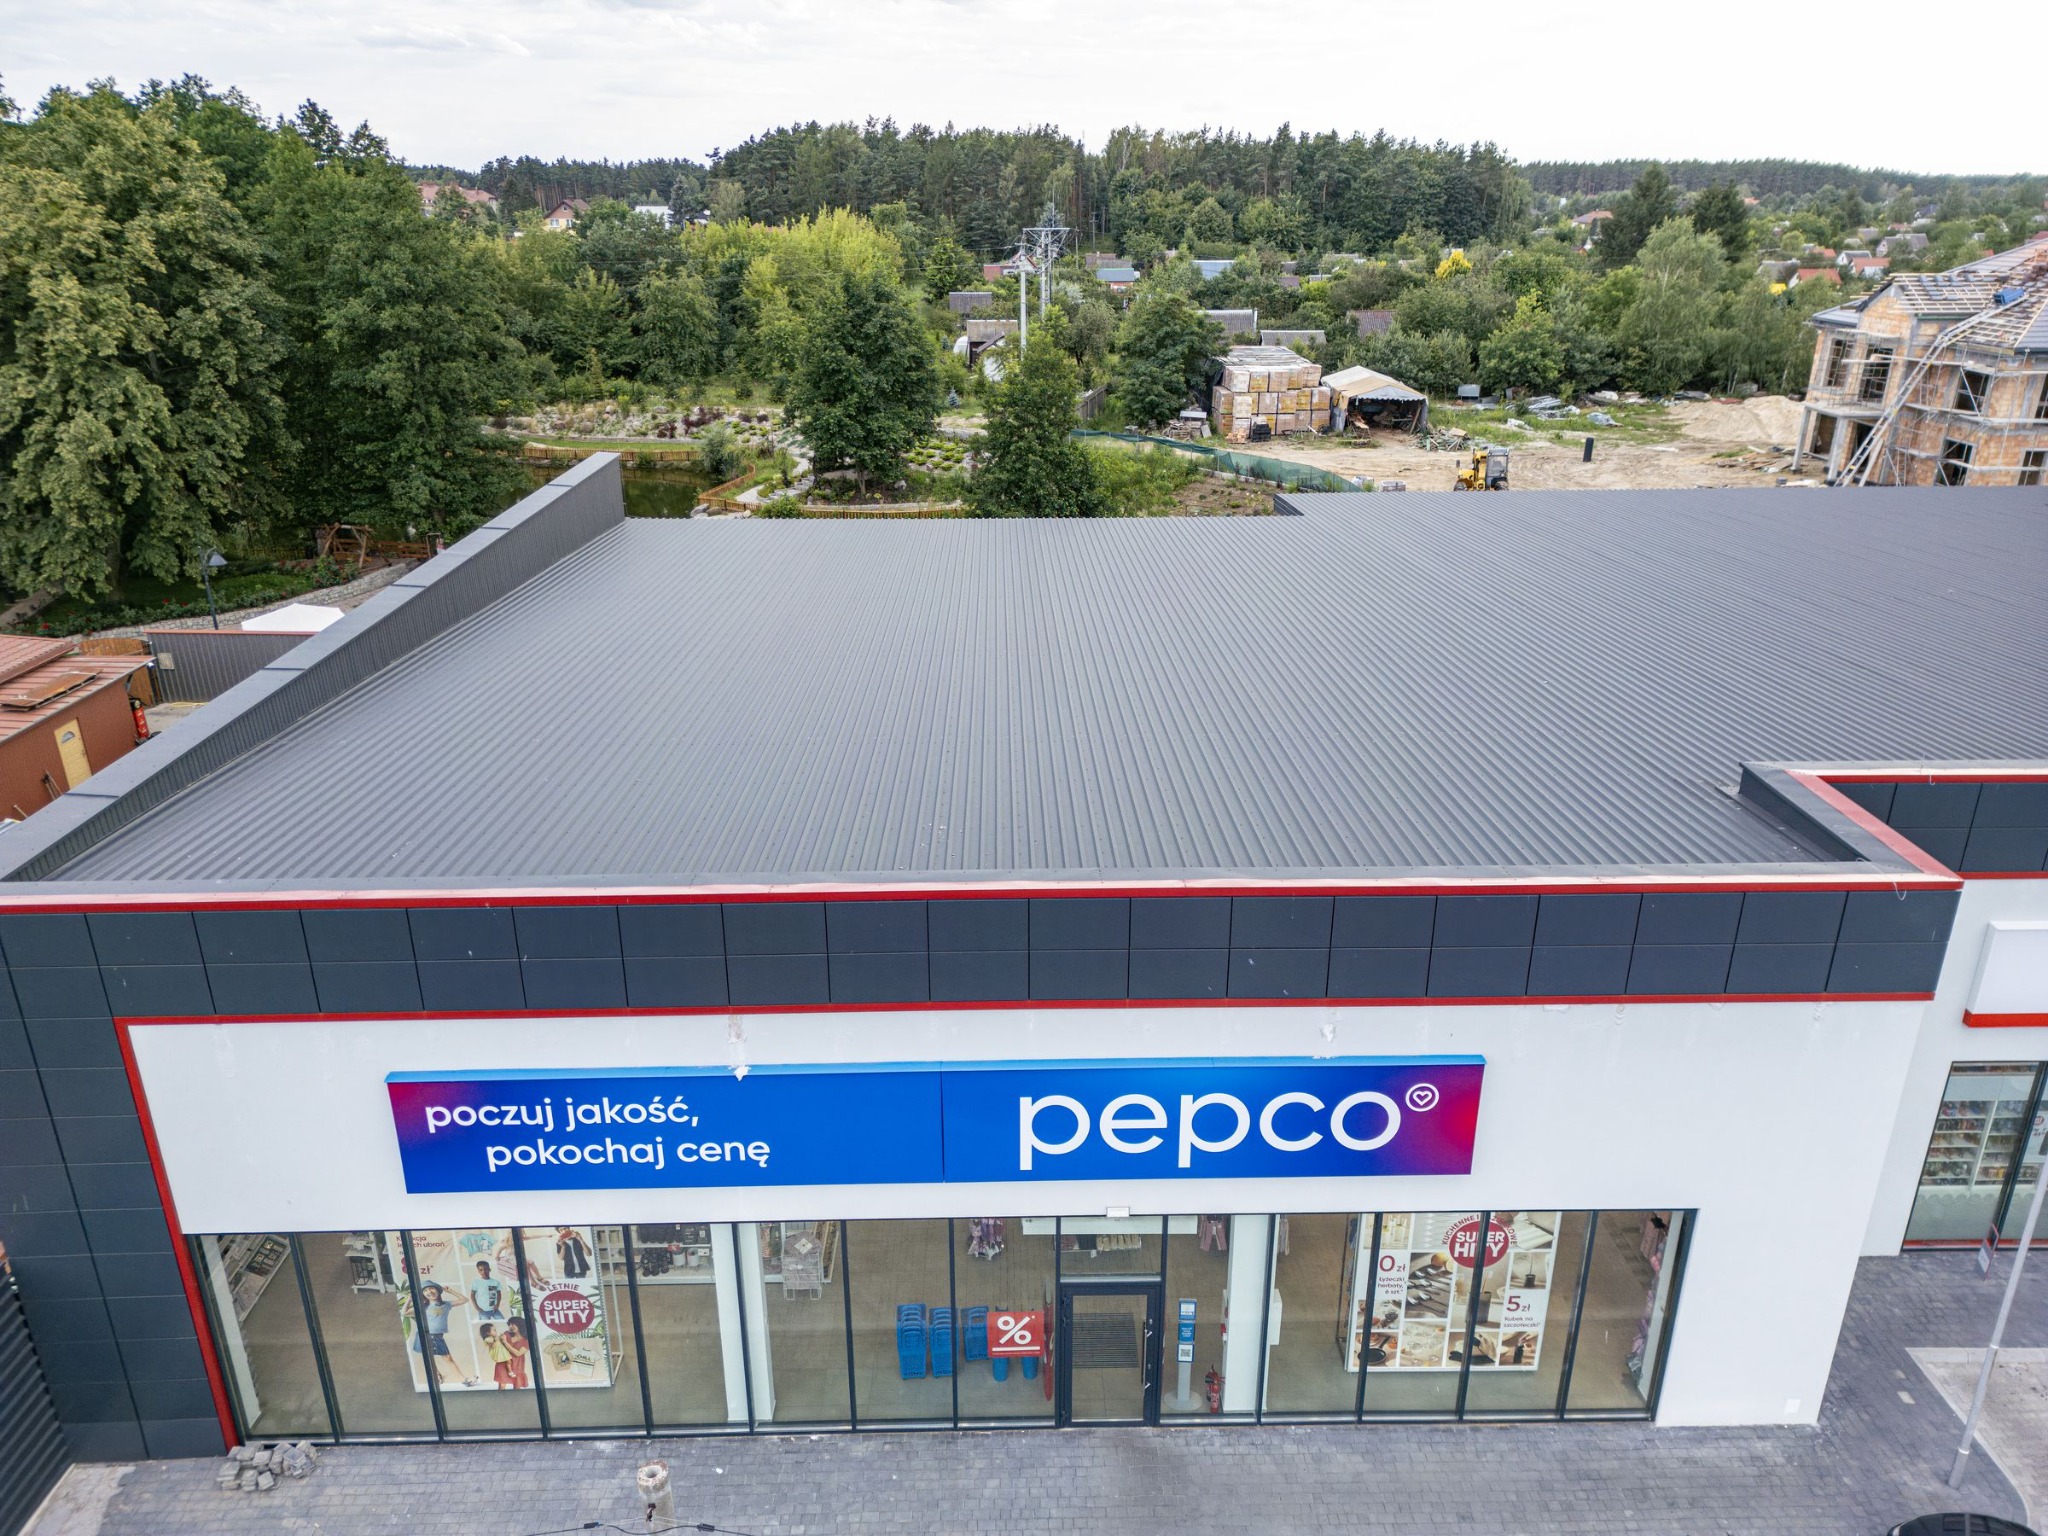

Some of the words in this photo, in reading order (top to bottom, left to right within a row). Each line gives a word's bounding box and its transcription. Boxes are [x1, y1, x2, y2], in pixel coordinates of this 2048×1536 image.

[425, 1097, 554, 1133] poczuj
[565, 1096, 699, 1132] jakość,
[1019, 1091, 1401, 1171] pepco
[486, 1136, 665, 1172] pokochaj
[677, 1141, 771, 1168] cenę
[1442, 1214, 1475, 1246] KUCHENNE
[1455, 1231, 1506, 1243] SUER
[1453, 1242, 1505, 1258] HIY
[547, 1283, 580, 1292] LETNIE
[543, 1299, 590, 1311] SUPER
[1506, 1295, 1521, 1312] 5
[544, 1310, 590, 1325] HITY
